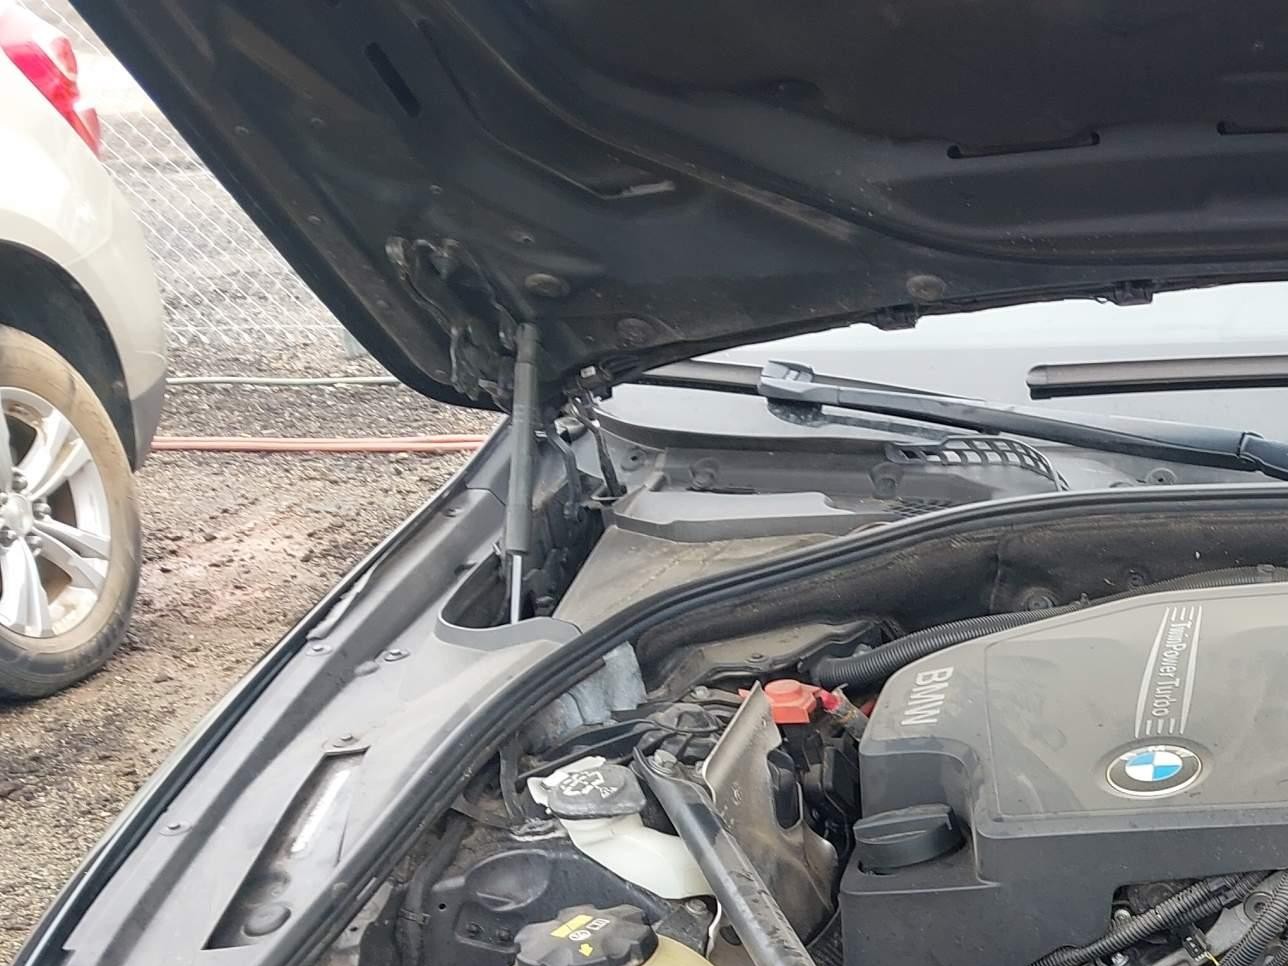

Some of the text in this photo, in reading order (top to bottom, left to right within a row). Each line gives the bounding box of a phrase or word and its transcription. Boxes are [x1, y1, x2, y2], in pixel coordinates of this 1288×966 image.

[1159, 620, 1193, 677] TwinPower
[901, 666, 954, 726] BMW
[1151, 678, 1180, 717] Turbo
